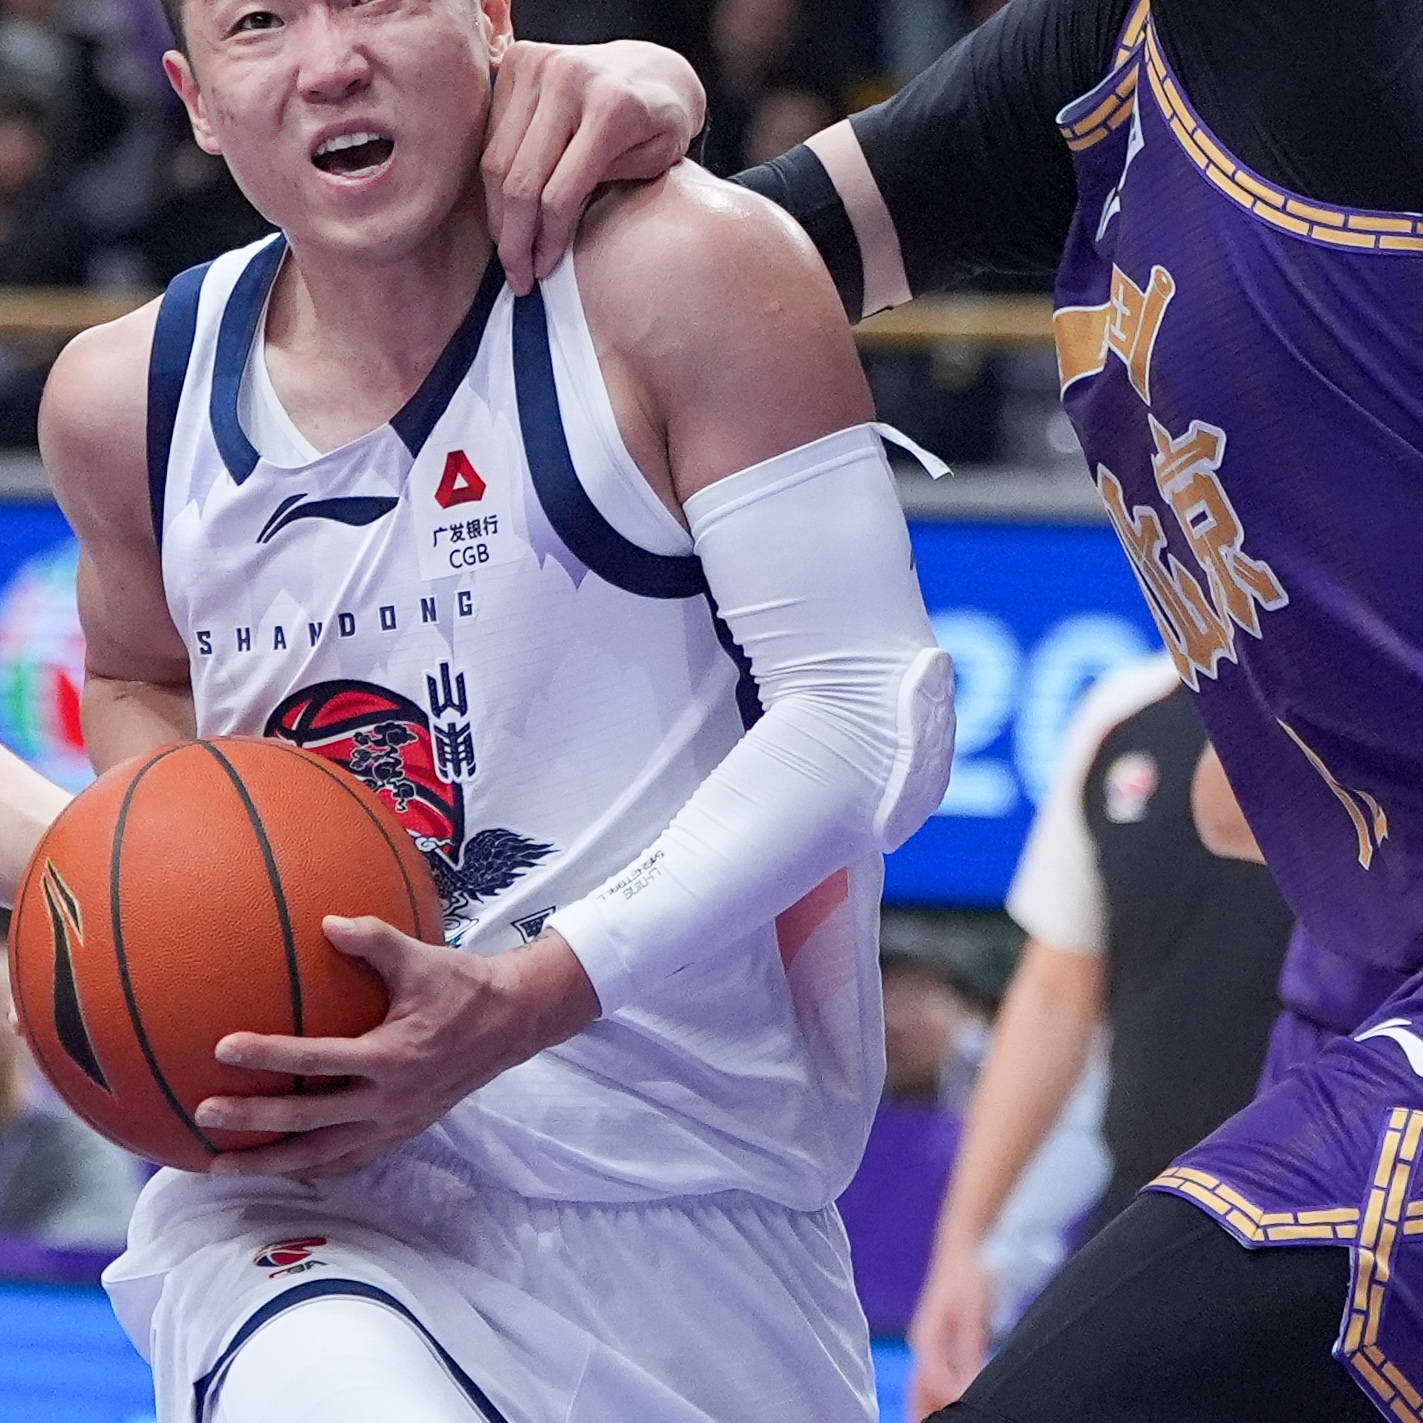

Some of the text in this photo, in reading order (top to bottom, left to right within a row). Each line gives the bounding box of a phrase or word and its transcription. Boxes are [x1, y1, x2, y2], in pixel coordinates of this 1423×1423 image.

[432, 514, 499, 548] 广发银行
[449, 543, 491, 569] CGB
[195, 590, 474, 656] SHANDONG
